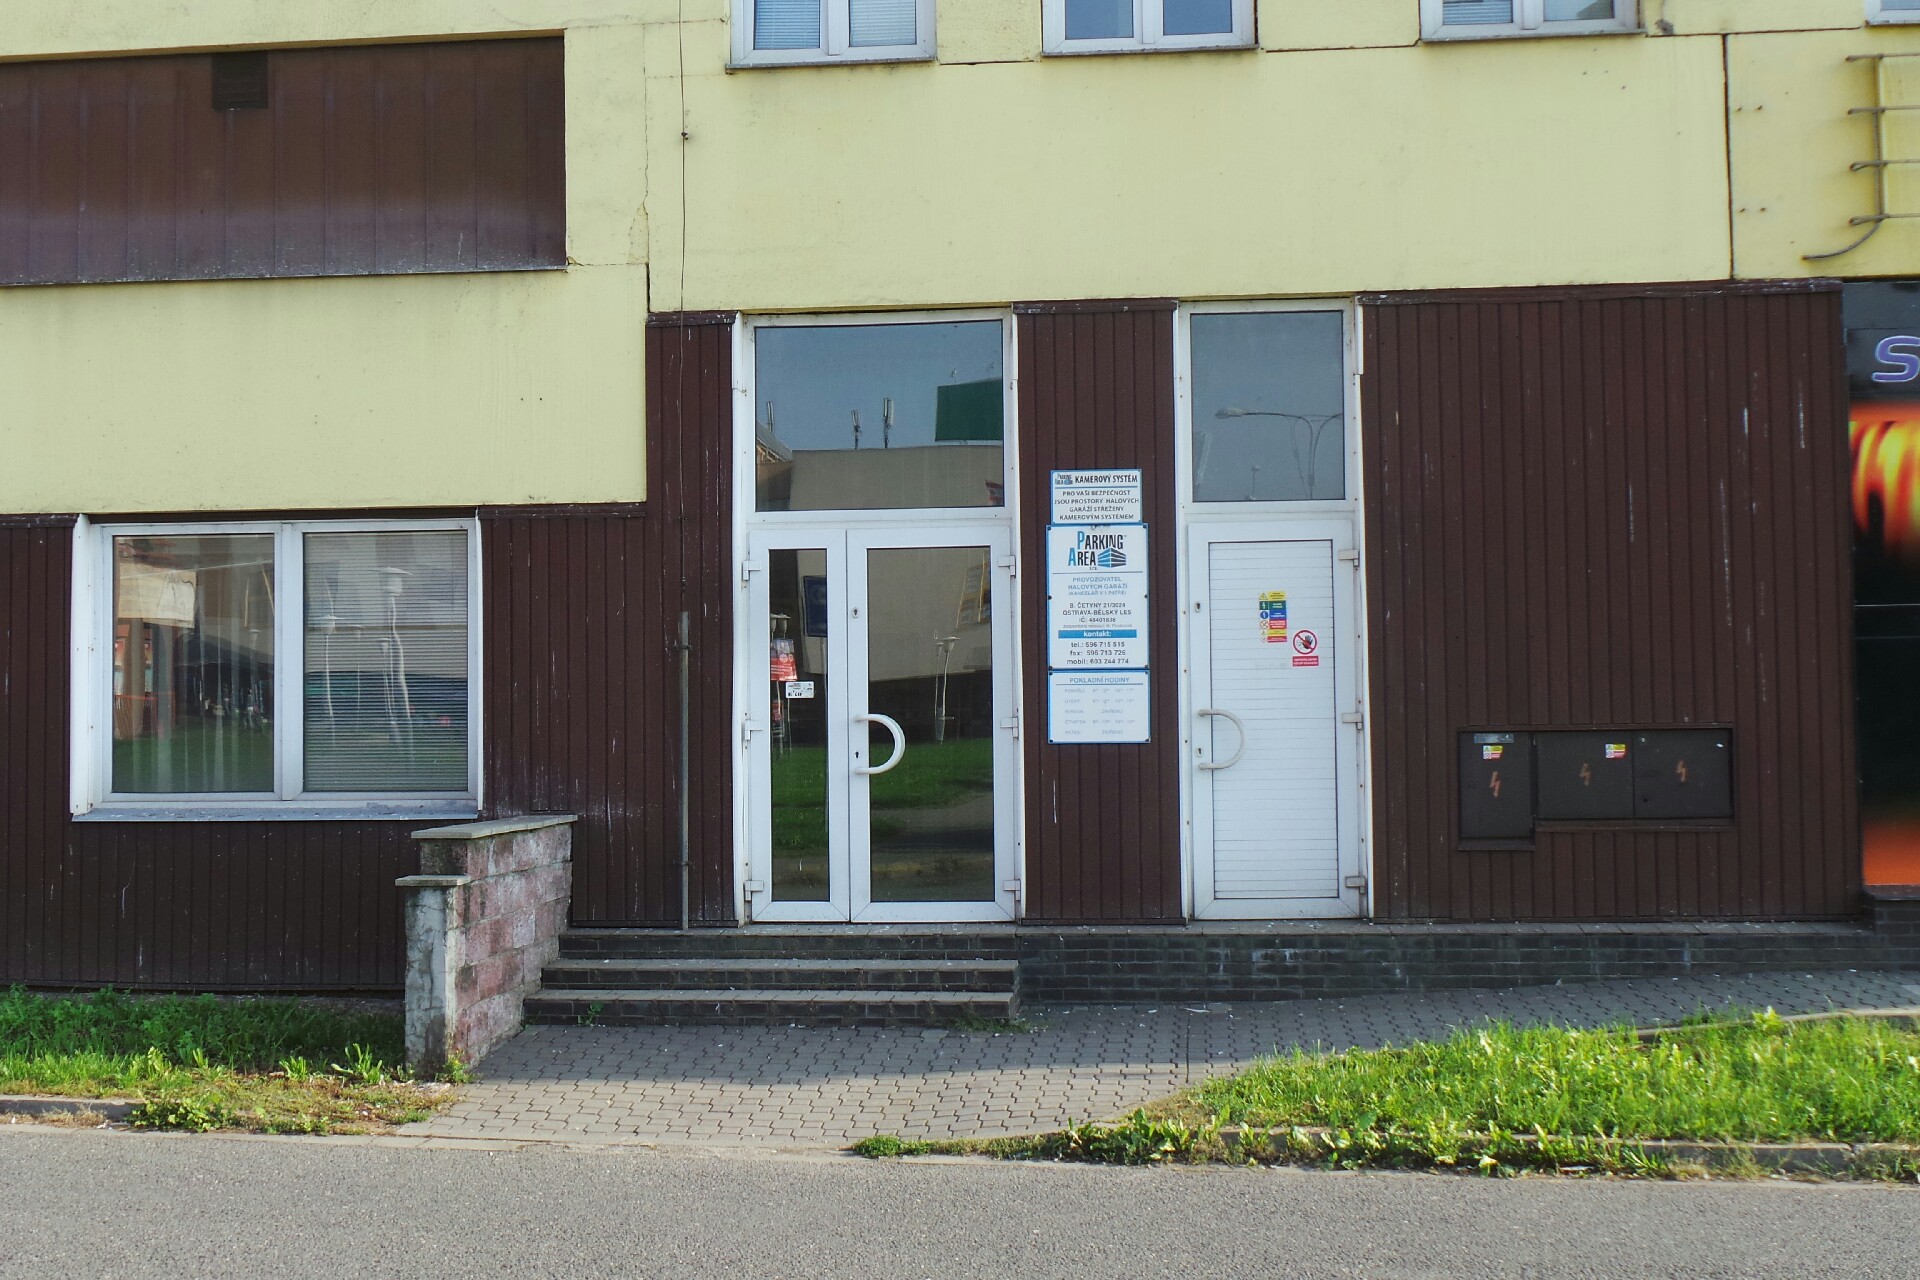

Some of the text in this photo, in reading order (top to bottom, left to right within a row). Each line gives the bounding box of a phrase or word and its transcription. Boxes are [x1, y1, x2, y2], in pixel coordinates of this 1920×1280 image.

[1075, 474, 1137, 483] KAMEROVÝ SYSTÉM
[1077, 531, 1123, 549] PARKING
[1068, 548, 1096, 566] AREA
